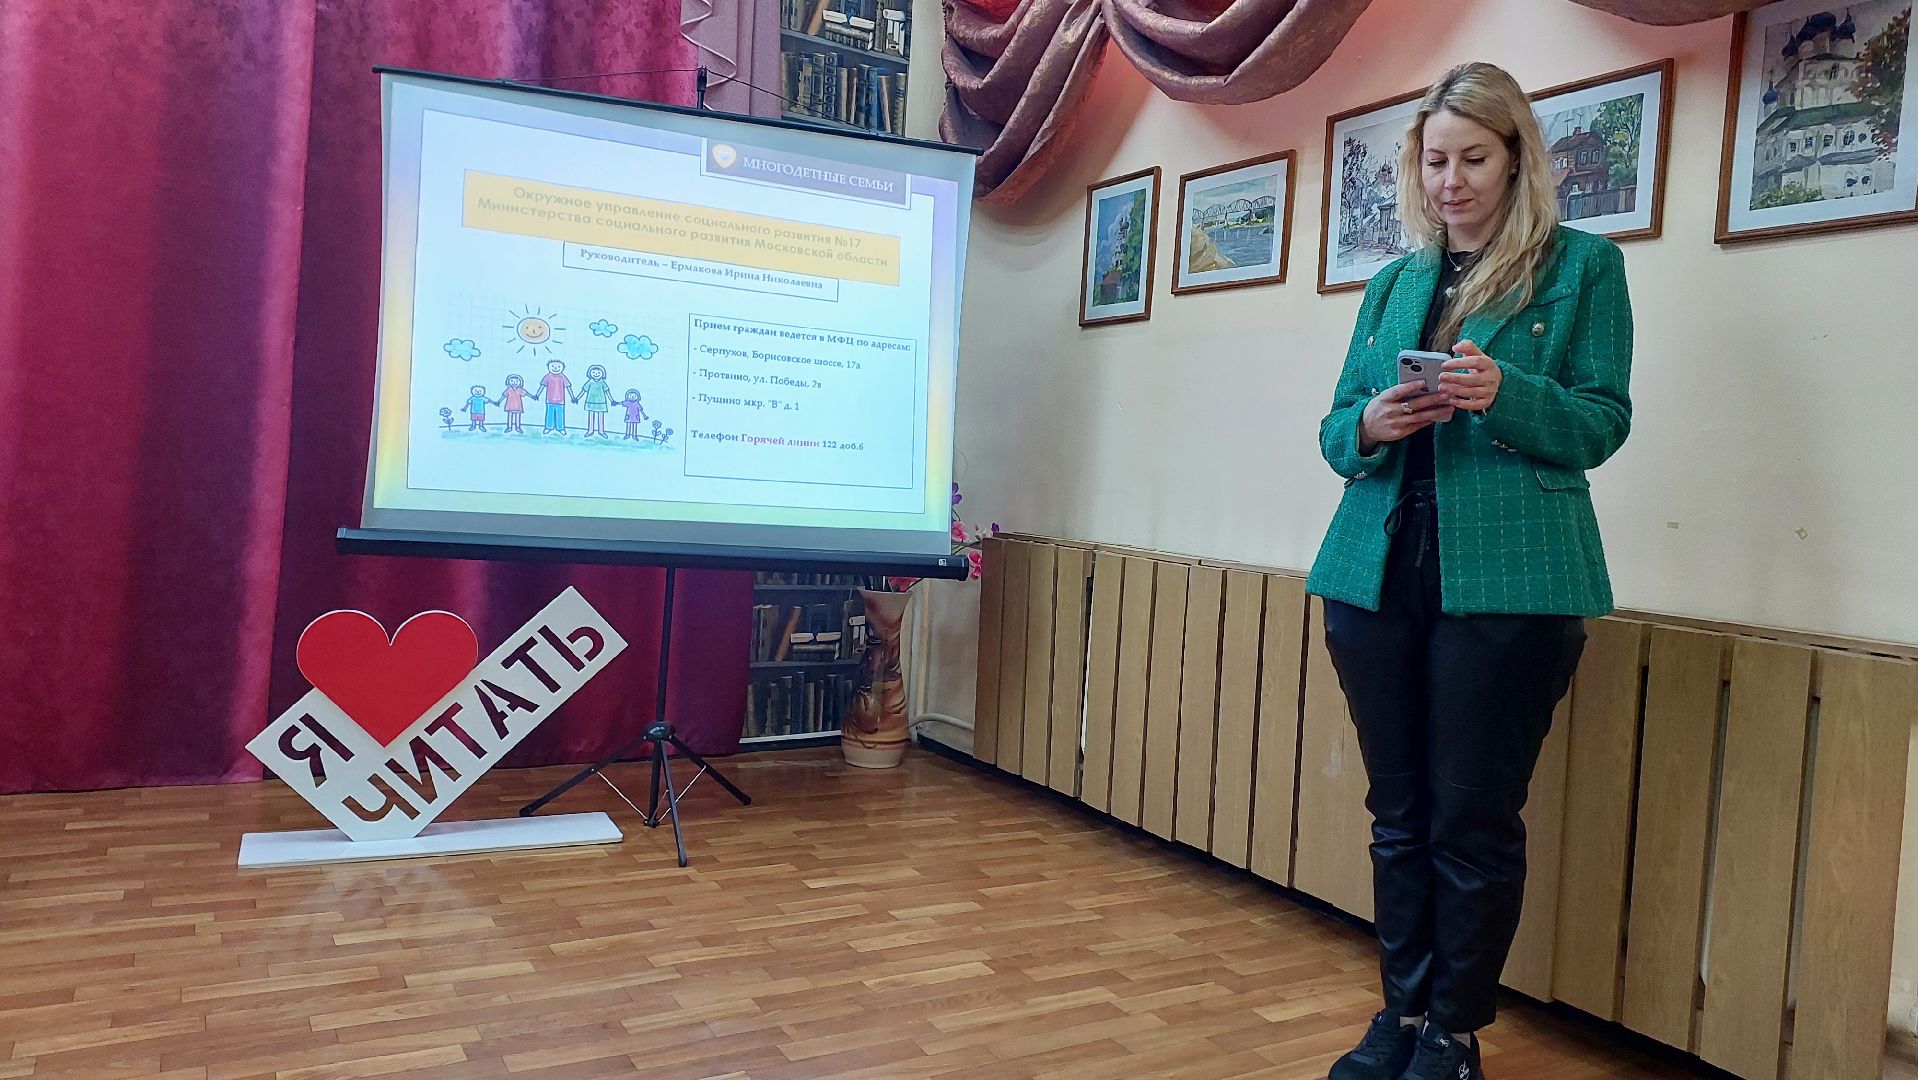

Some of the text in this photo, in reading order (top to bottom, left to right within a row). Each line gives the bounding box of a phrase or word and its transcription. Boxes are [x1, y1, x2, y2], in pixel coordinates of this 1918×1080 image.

[743, 156, 894, 193] МНОГОДЕТНЫЕ СЕМЬИ
[478, 198, 888, 267] Министерства социального развития Московской области
[513, 186, 862, 249] Окружное управление социального развития №17
[580, 248, 660, 267] Руководитель
[671, 260, 722, 276] Ермакова
[724, 268, 760, 282] Ирина
[762, 273, 823, 290] Николаевна
[694, 318, 731, 332] Прием
[733, 324, 777, 338] граждан
[779, 329, 817, 342] ведется
[826, 334, 855, 346] МФЦ
[856, 338, 869, 347] по
[870, 340, 912, 352] адресам:
[699, 344, 750, 360] Серпухов,
[752, 350, 812, 365] Борисовское
[814, 358, 844, 368] шоссе,
[846, 360, 861, 370] 17а
[699, 368, 751, 384] Протвино,
[753, 375, 768, 385] ул.
[770, 375, 810, 388] Победы,
[698, 393, 741, 406] Пущино
[743, 398, 765, 409] мкр.
[794, 402, 800, 411] 1
[691, 430, 864, 451] Телефон Горячей линии 122 доб.6
[341, 624, 605, 822] ЧИТАТЬ
[277, 712, 355, 788] Я
